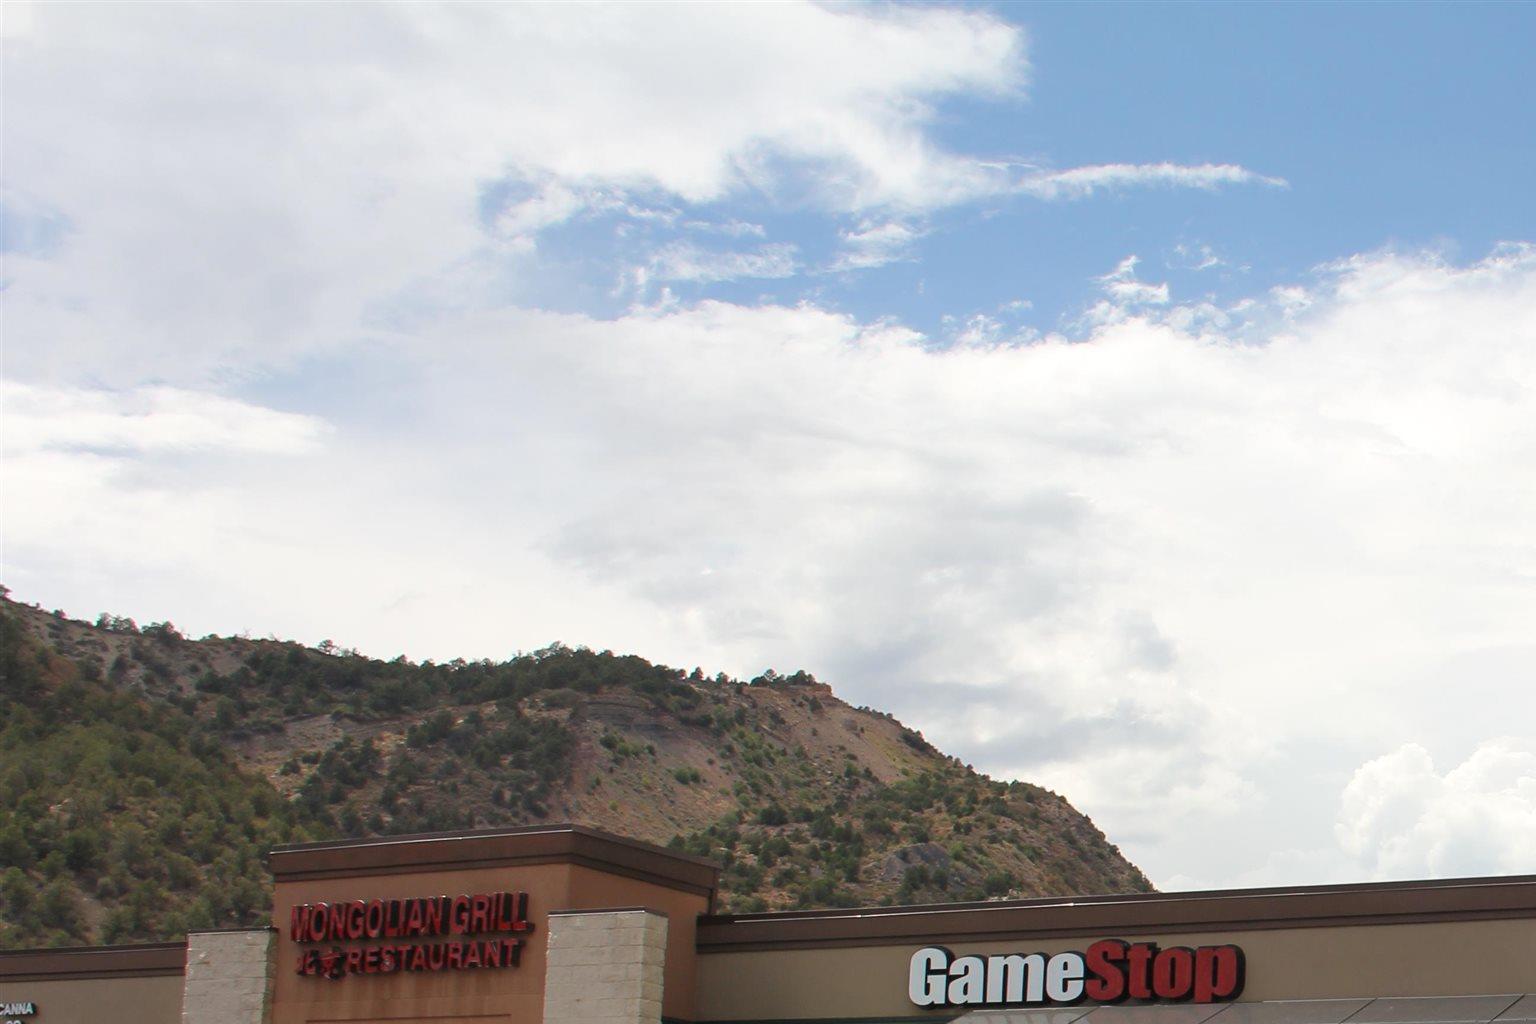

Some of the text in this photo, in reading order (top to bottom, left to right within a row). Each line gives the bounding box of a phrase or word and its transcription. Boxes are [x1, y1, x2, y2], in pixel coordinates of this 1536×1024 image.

[290, 892, 531, 942] MONGOLIAN GRILL
[347, 938, 522, 975] RESTAURANT
[908, 938, 1241, 1007] GameStop
